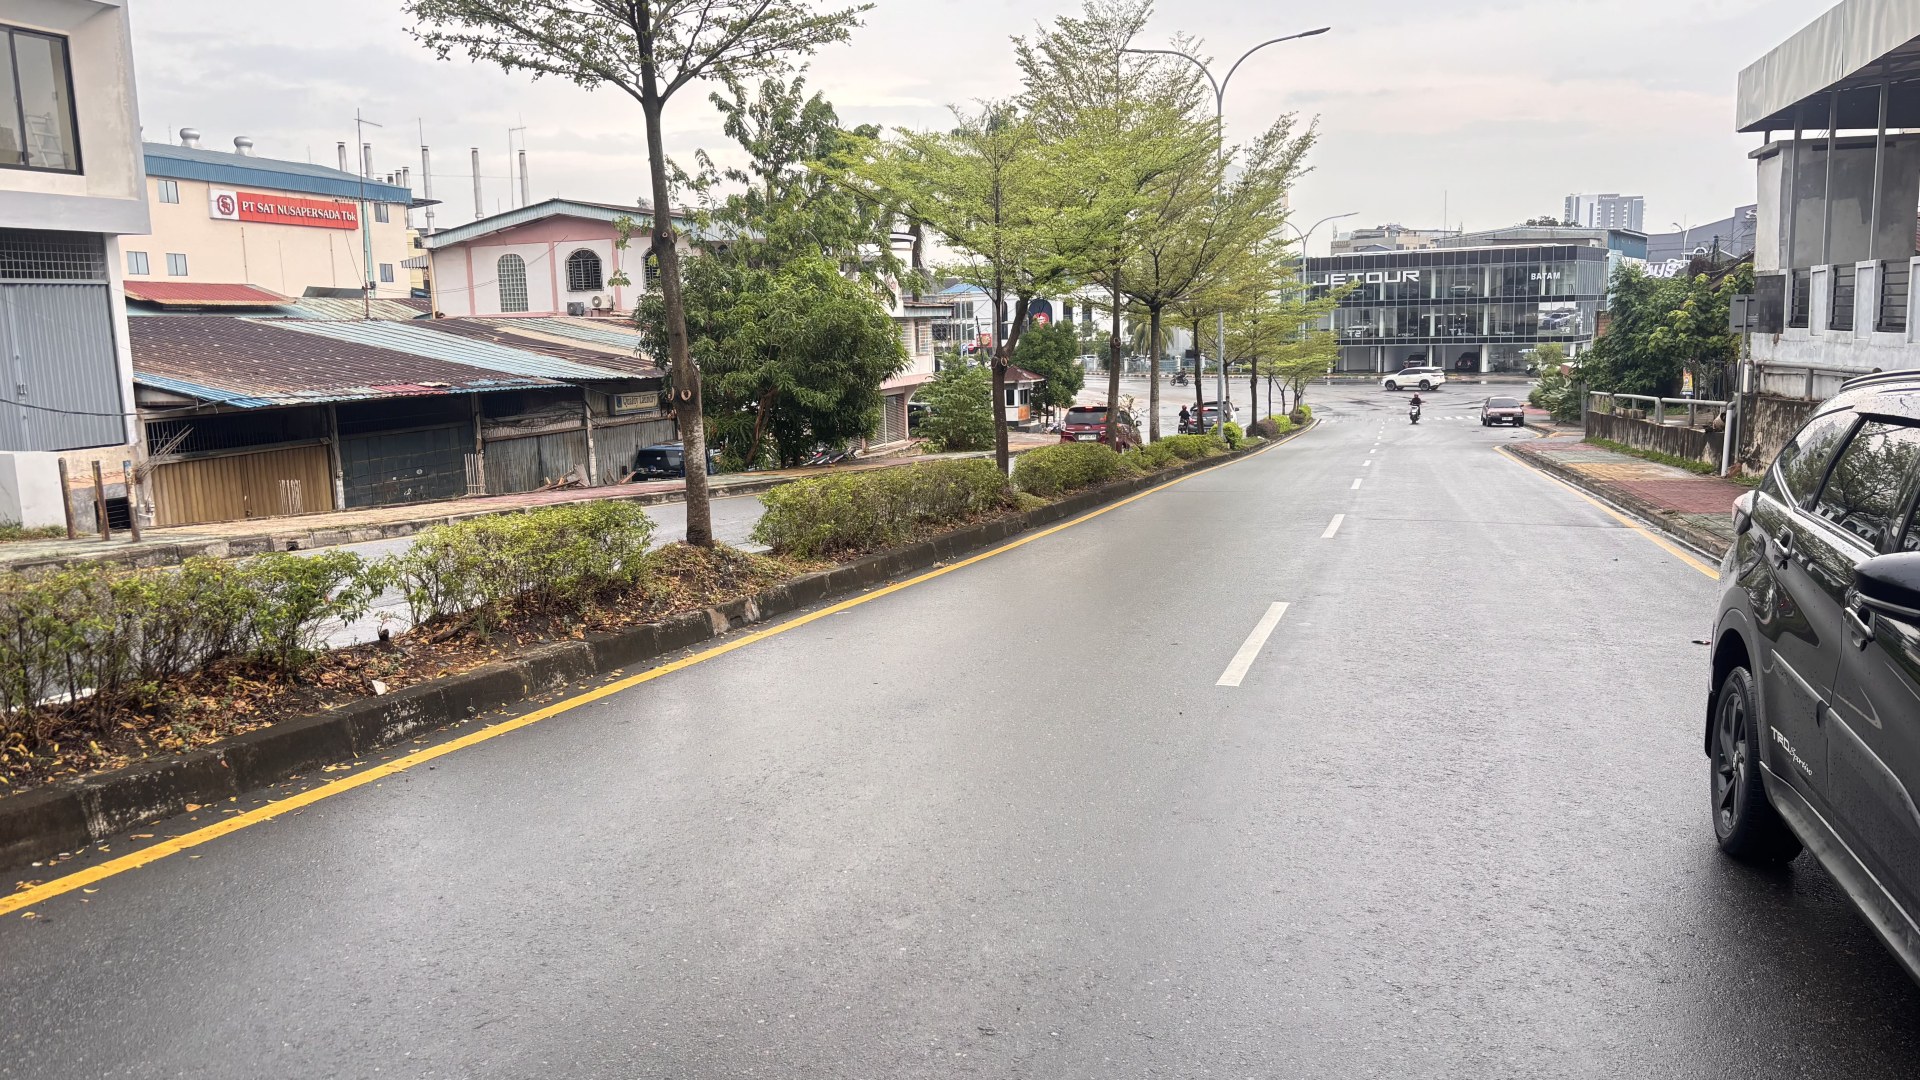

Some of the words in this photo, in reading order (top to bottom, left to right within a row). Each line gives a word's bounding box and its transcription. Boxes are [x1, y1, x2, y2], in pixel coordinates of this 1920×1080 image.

[241, 201, 254, 212] PT
[257, 202, 275, 214] SAT
[277, 205, 340, 220] NUSAPERSADA
[341, 210, 356, 221] Tbk
[1313, 270, 1420, 286] JETOUR
[1530, 271, 1561, 280] BATAM
[1770, 725, 1790, 752] TRD
[1789, 746, 1812, 776] Sportivo
